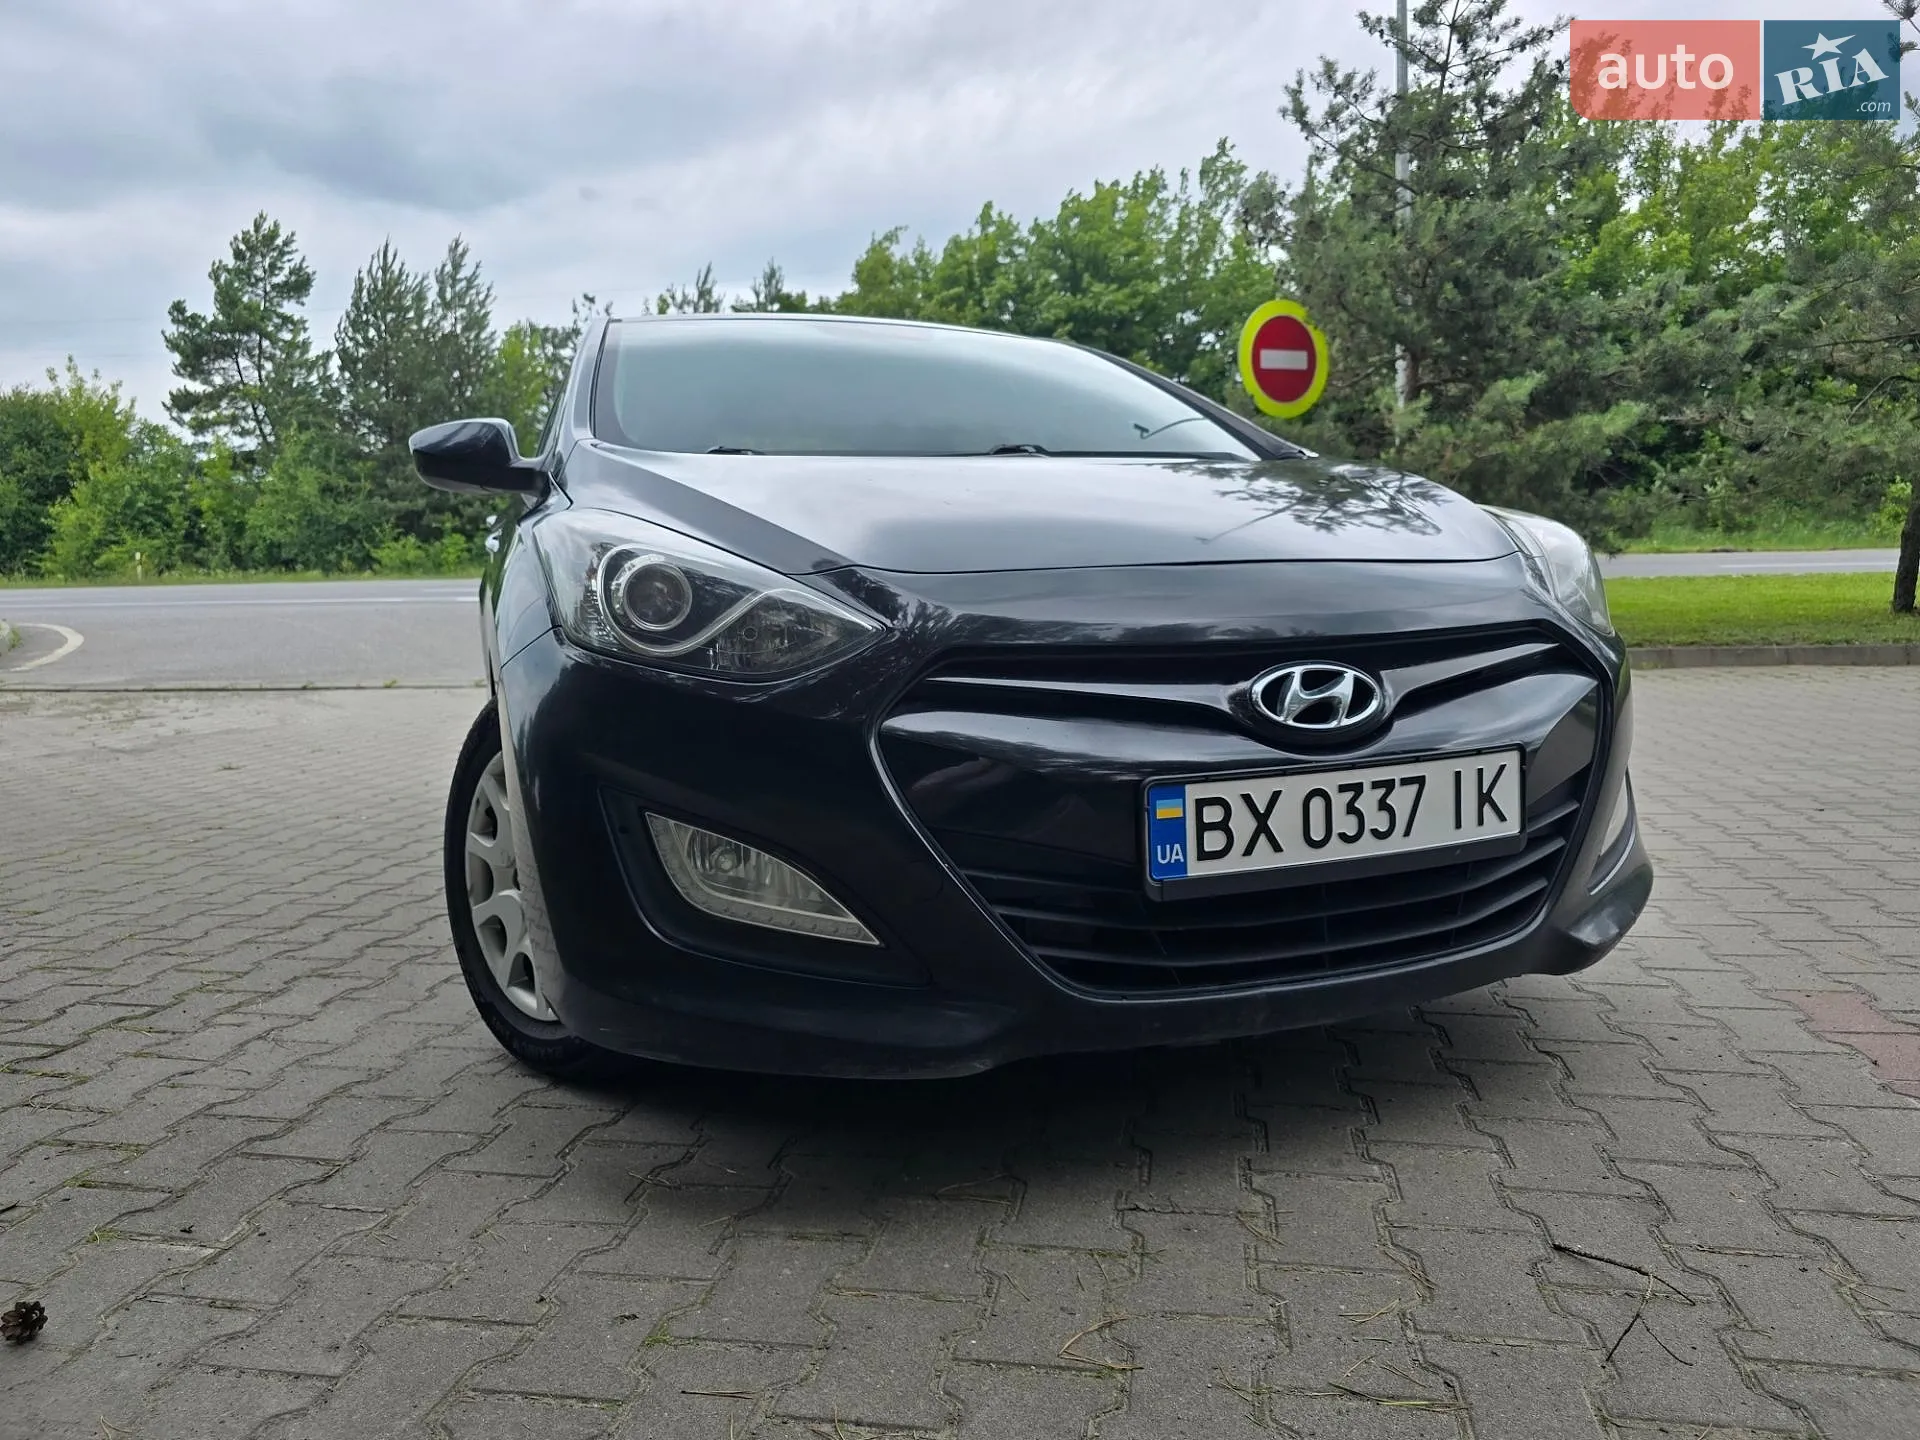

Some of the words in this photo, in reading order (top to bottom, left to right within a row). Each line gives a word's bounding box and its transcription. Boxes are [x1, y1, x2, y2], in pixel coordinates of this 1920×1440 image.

[1194, 789, 1284, 862] BX
[1302, 774, 1427, 850] 0337
[1452, 763, 1508, 830] IK
[1156, 843, 1185, 865] UA
